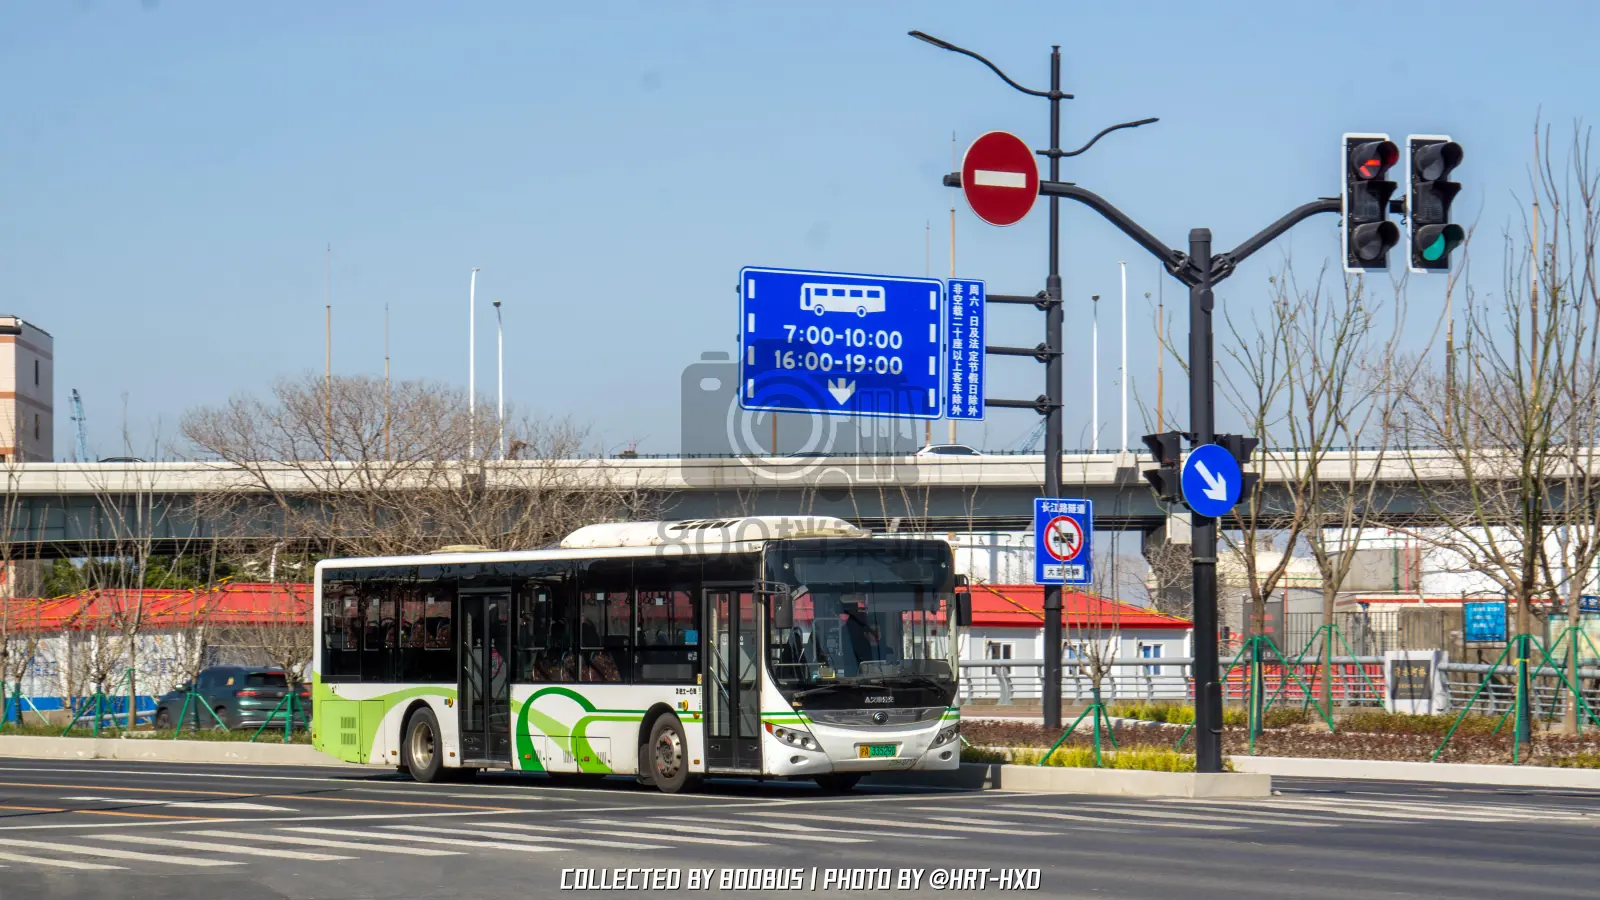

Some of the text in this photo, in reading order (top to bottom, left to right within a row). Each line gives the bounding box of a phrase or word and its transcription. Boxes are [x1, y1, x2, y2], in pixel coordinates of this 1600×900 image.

[783, 324, 903, 349] 7:00-10:00
[951, 283, 964, 416] 非空载二十座以上客车除外
[967, 284, 980, 417] 周六、日及法定节假日除外
[774, 350, 903, 375] 16:00-19:00
[1041, 501, 1086, 514] 长江路隧道
